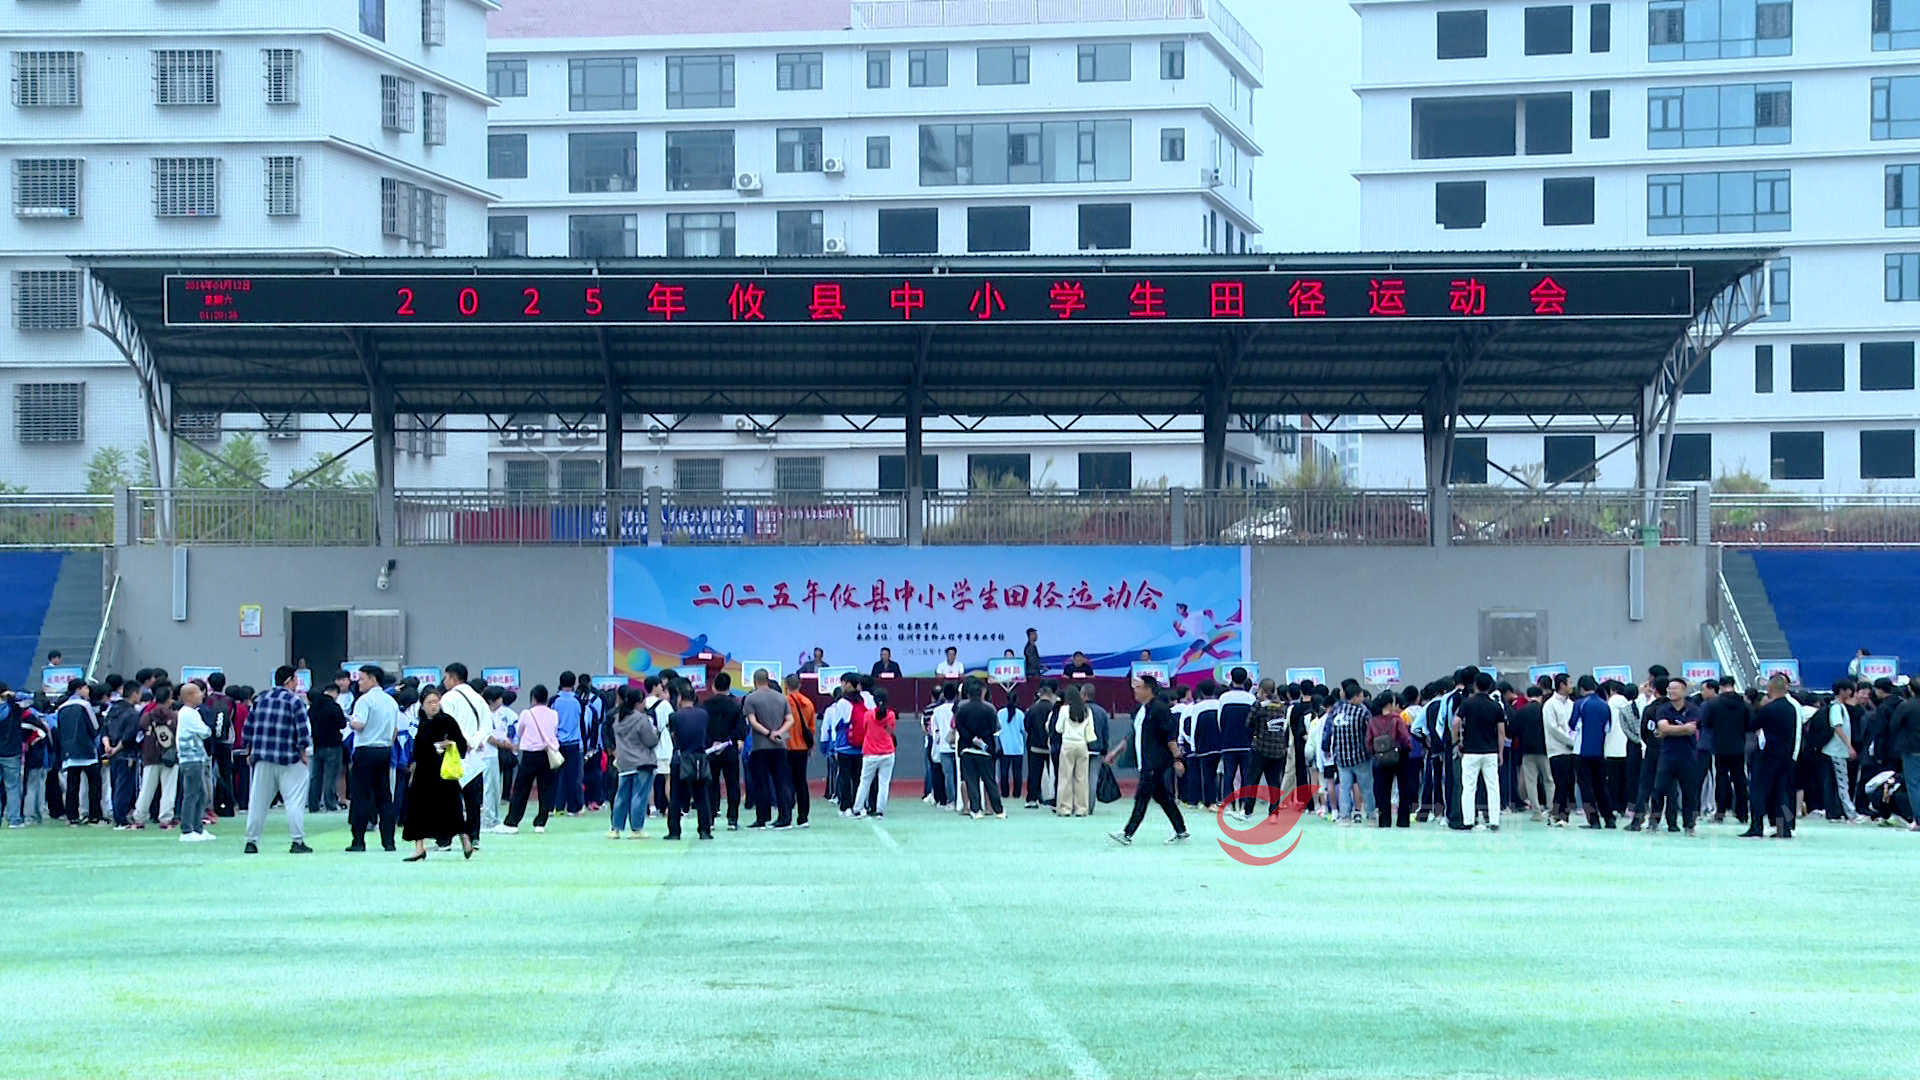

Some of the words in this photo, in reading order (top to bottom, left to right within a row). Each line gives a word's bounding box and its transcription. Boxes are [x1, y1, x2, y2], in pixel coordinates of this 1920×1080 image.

[397, 279, 1567, 321] 2025年攸县中小学生田径运动会
